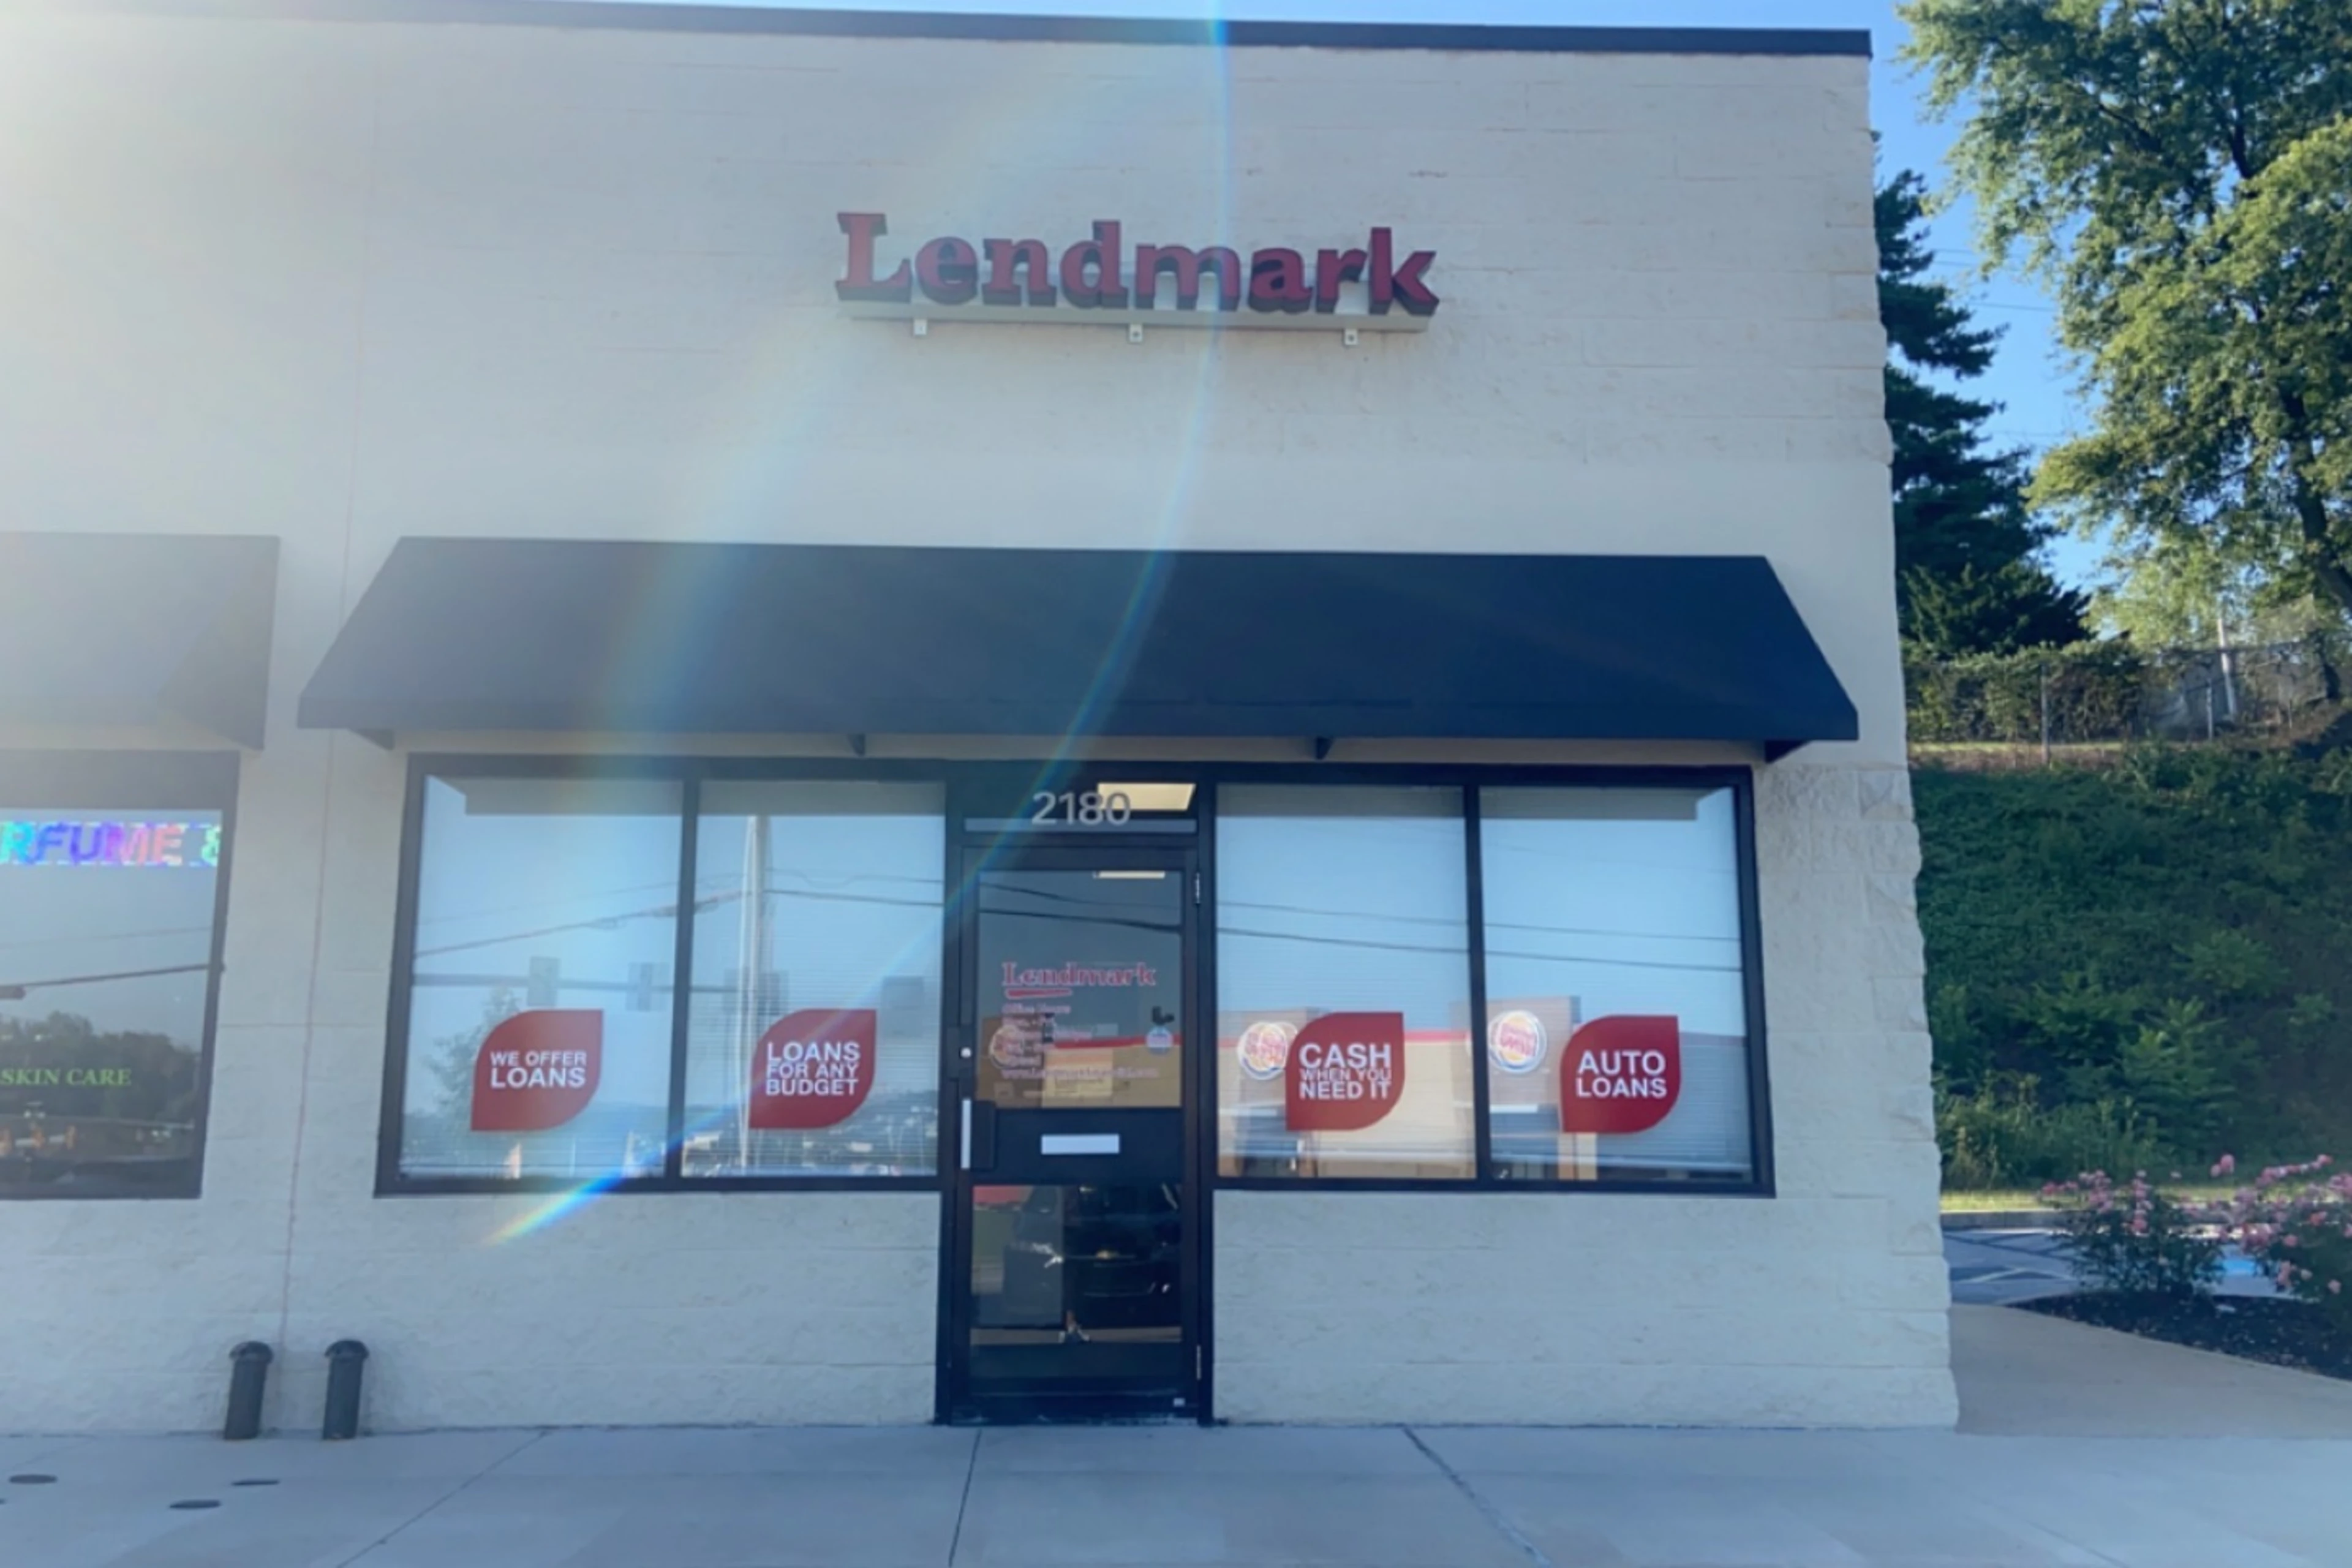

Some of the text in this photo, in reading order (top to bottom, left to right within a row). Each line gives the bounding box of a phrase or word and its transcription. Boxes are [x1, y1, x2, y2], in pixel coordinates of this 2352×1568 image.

[835, 213, 1439, 317] Lendmark
[1032, 792, 1131, 825] 2180
[1001, 961, 1156, 986] Lendmark
[491, 1050, 587, 1066] WE OFFER
[767, 1041, 861, 1062] LOANS
[1298, 1042, 1392, 1069] CASH
[767, 1063, 859, 1079] FOR ANY
[1577, 1050, 1666, 1075] AUTO
[0, 1068, 132, 1086] SKIN CARE
[491, 1067, 586, 1089] LOANS
[1300, 1068, 1392, 1082] WHEN YOU
[766, 1079, 859, 1096] BUDGET
[1298, 1080, 1392, 1099] NEED IT
[1575, 1077, 1667, 1098] LOANS
